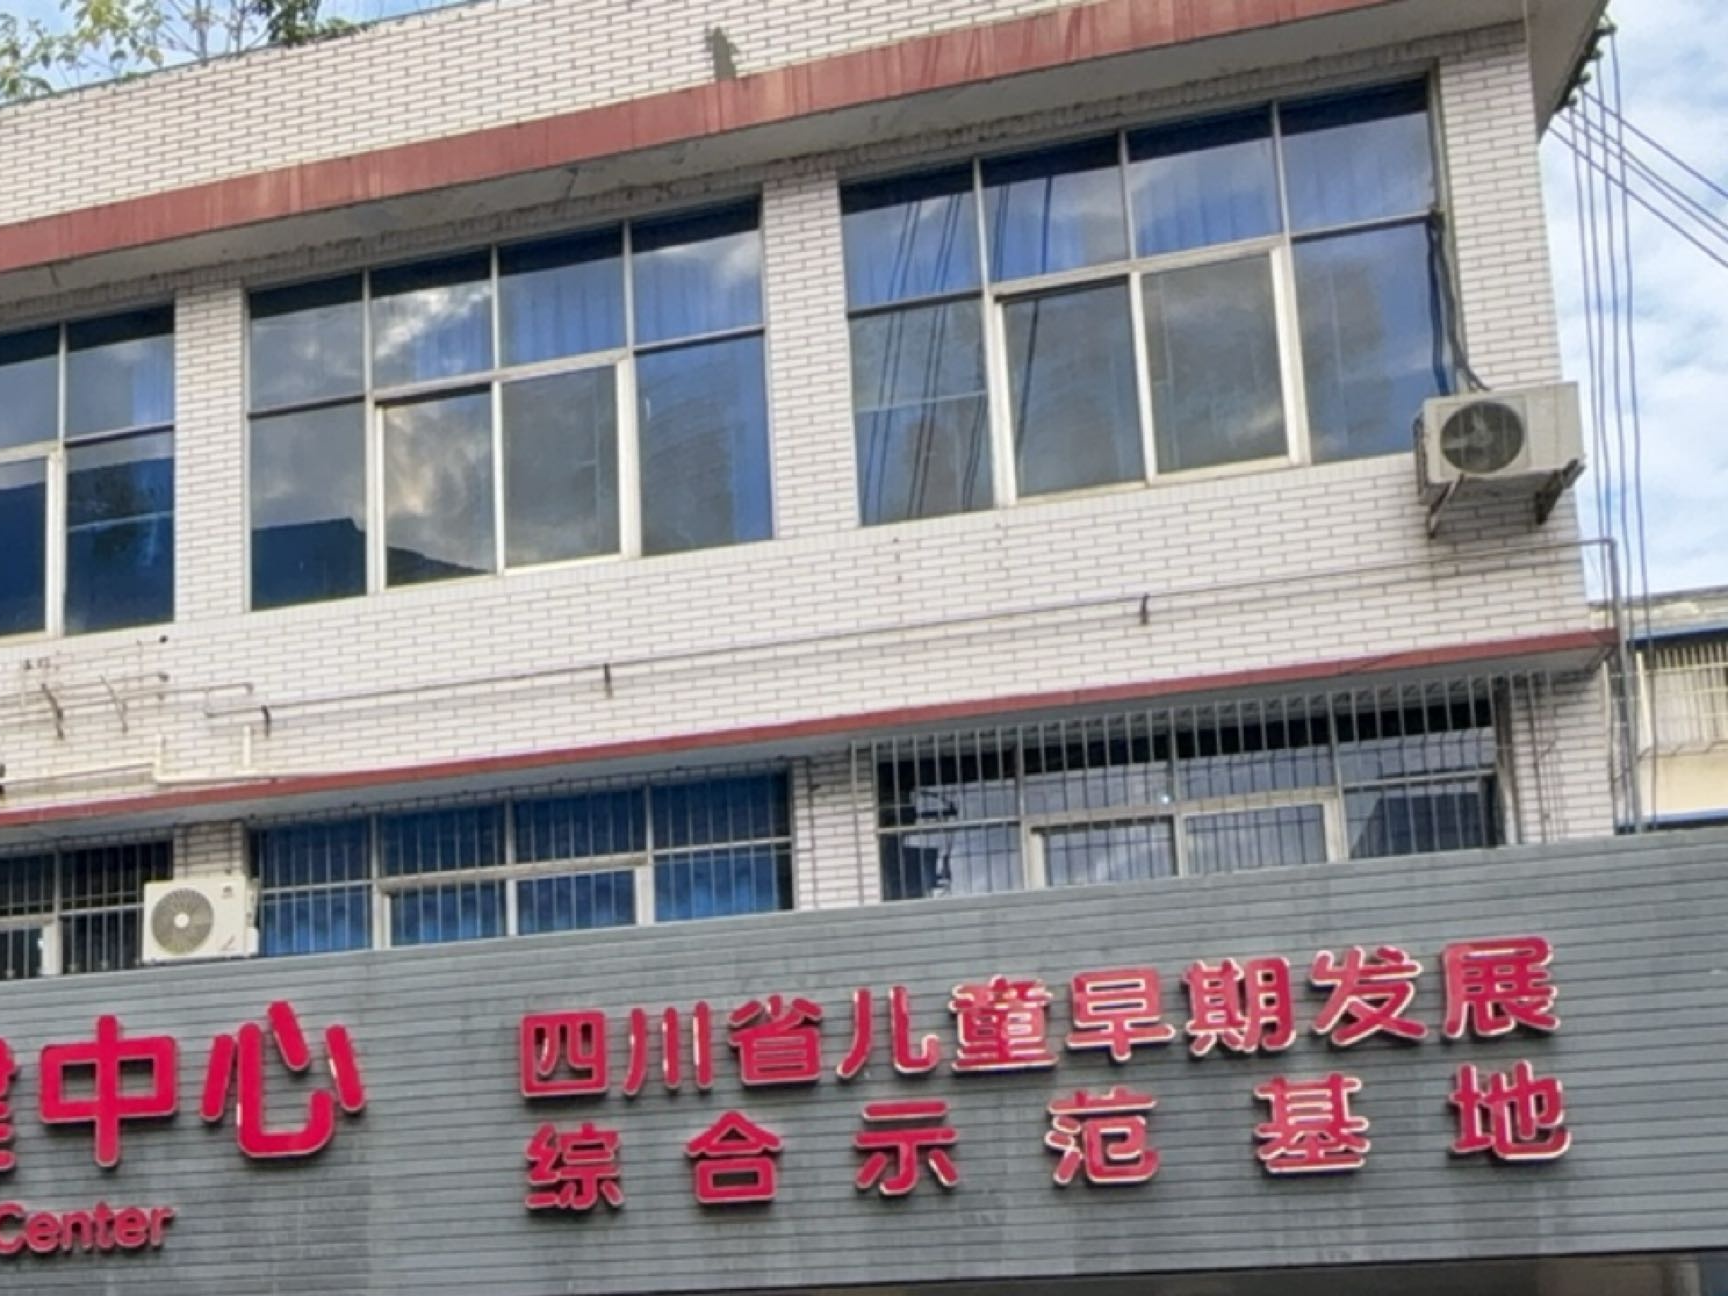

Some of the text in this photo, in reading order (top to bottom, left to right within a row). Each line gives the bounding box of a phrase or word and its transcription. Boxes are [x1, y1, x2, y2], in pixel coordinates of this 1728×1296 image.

[519, 936, 1561, 1098] 四川省儿童早期发展
[524, 1061, 1572, 1213] 综合示范基地
